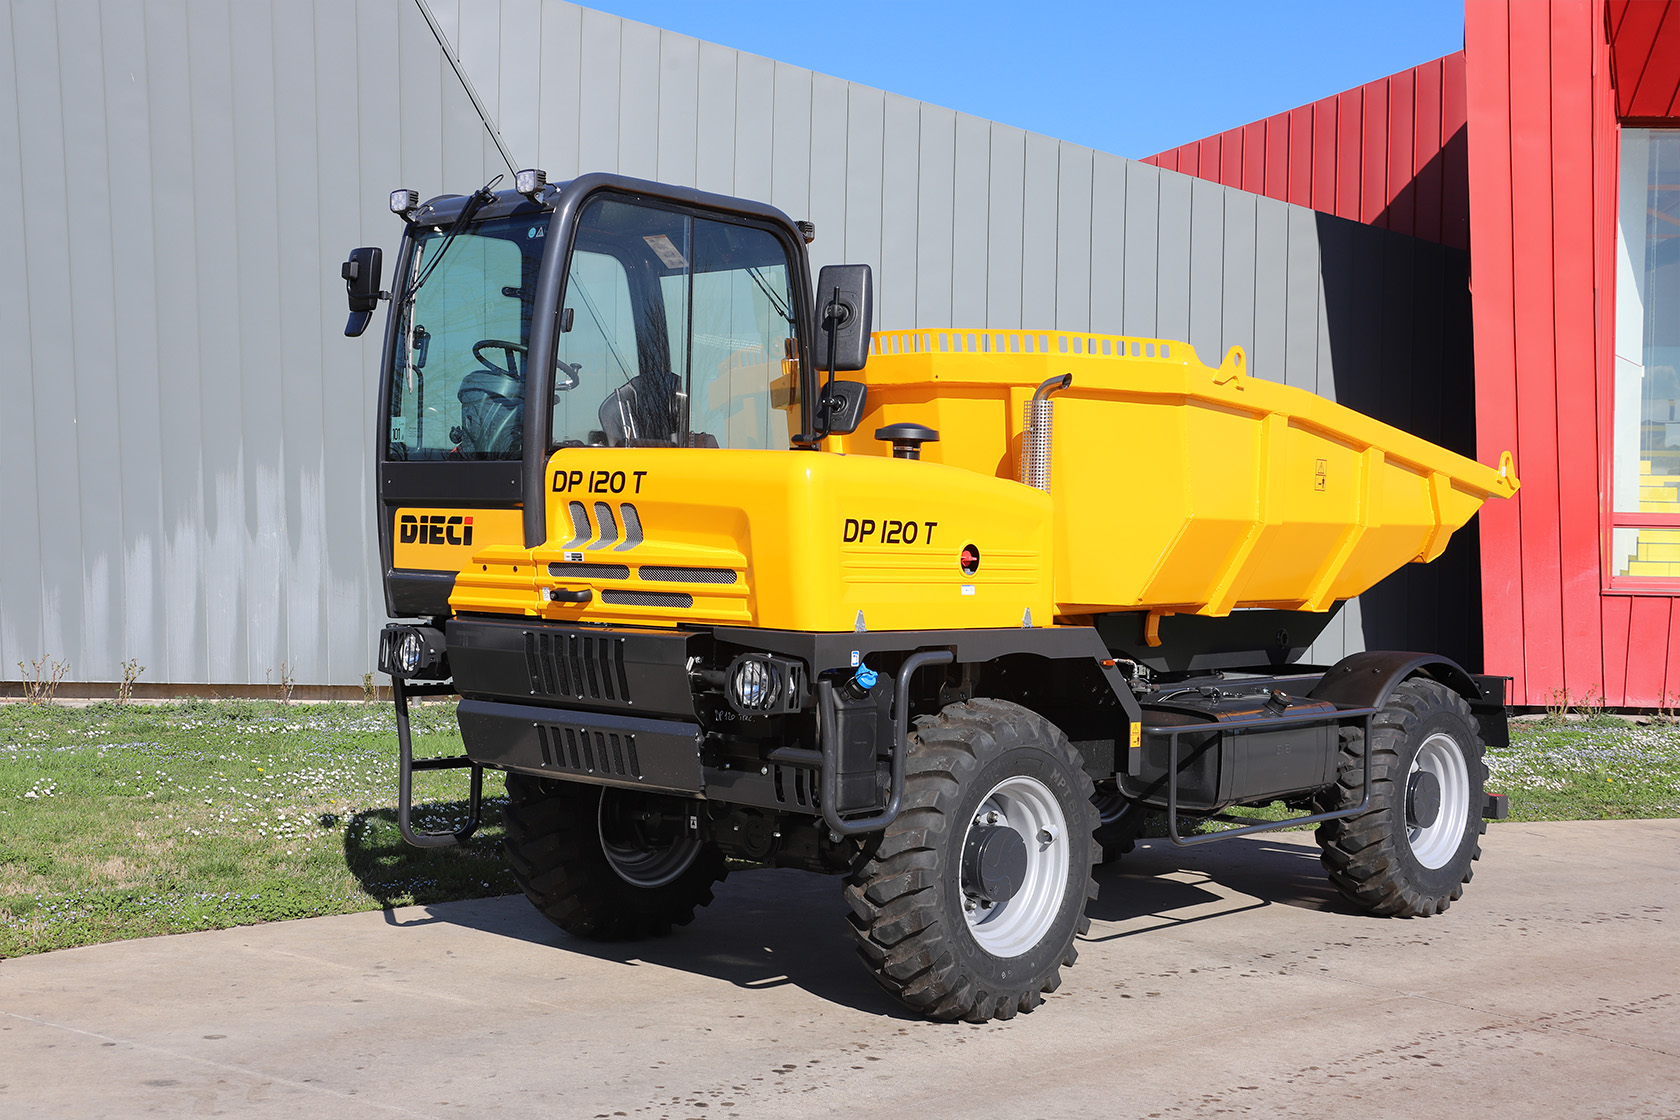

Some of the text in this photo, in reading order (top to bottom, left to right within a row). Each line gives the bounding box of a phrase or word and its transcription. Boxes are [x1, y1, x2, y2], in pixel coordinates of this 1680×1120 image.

[552, 470, 648, 494] DP 120 T
[843, 518, 938, 545] DP 120 T
[1049, 766, 1072, 799] MPT
